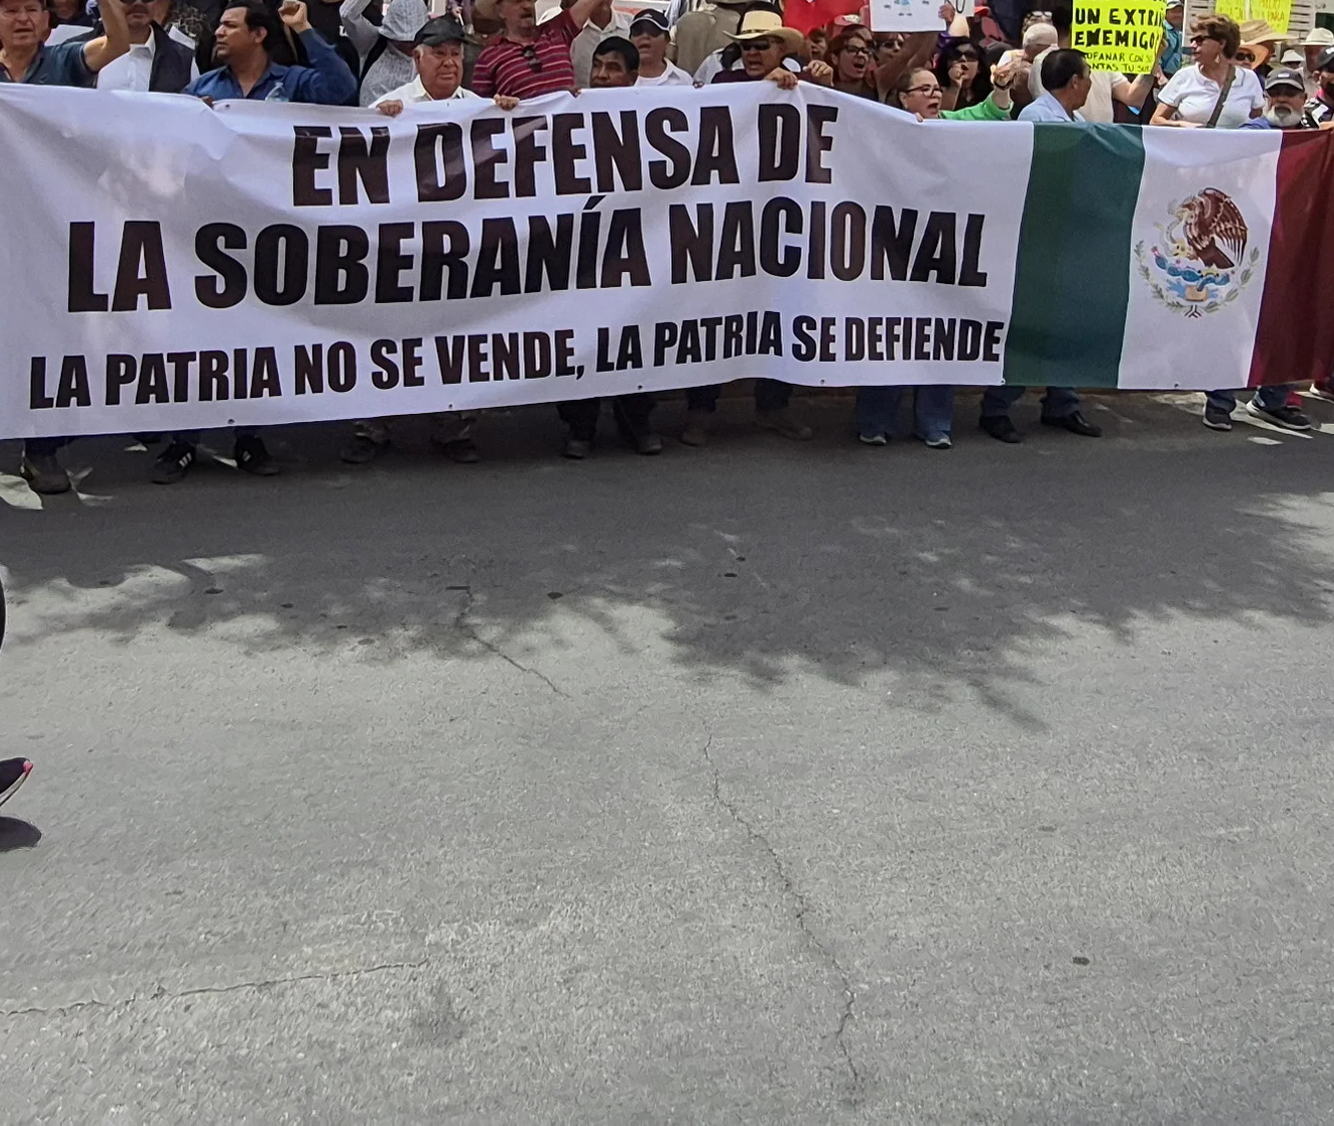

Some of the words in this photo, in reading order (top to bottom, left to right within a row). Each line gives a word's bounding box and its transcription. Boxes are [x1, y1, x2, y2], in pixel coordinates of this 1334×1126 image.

[1075, 7, 1101, 25] UN
[1085, 51, 1125, 63] OFANAR
[1089, 62, 1119, 72] NTAS
[292, 125, 391, 206] EN
[413, 105, 740, 203] DEFENSA
[758, 103, 839, 185] DE
[67, 220, 172, 313] LA
[193, 194, 652, 310] SOBERANÍA
[669, 196, 988, 288] NACIONAL
[29, 354, 92, 410] LA
[105, 346, 282, 406] PATRIA
[294, 341, 357, 395] NO
[370, 337, 425, 390] SE
[435, 329, 585, 384] VENDE,
[596, 325, 643, 373] LA
[653, 310, 783, 367] PATRIA
[791, 315, 836, 363] SE
[844, 316, 1005, 363] DEFIENDE
